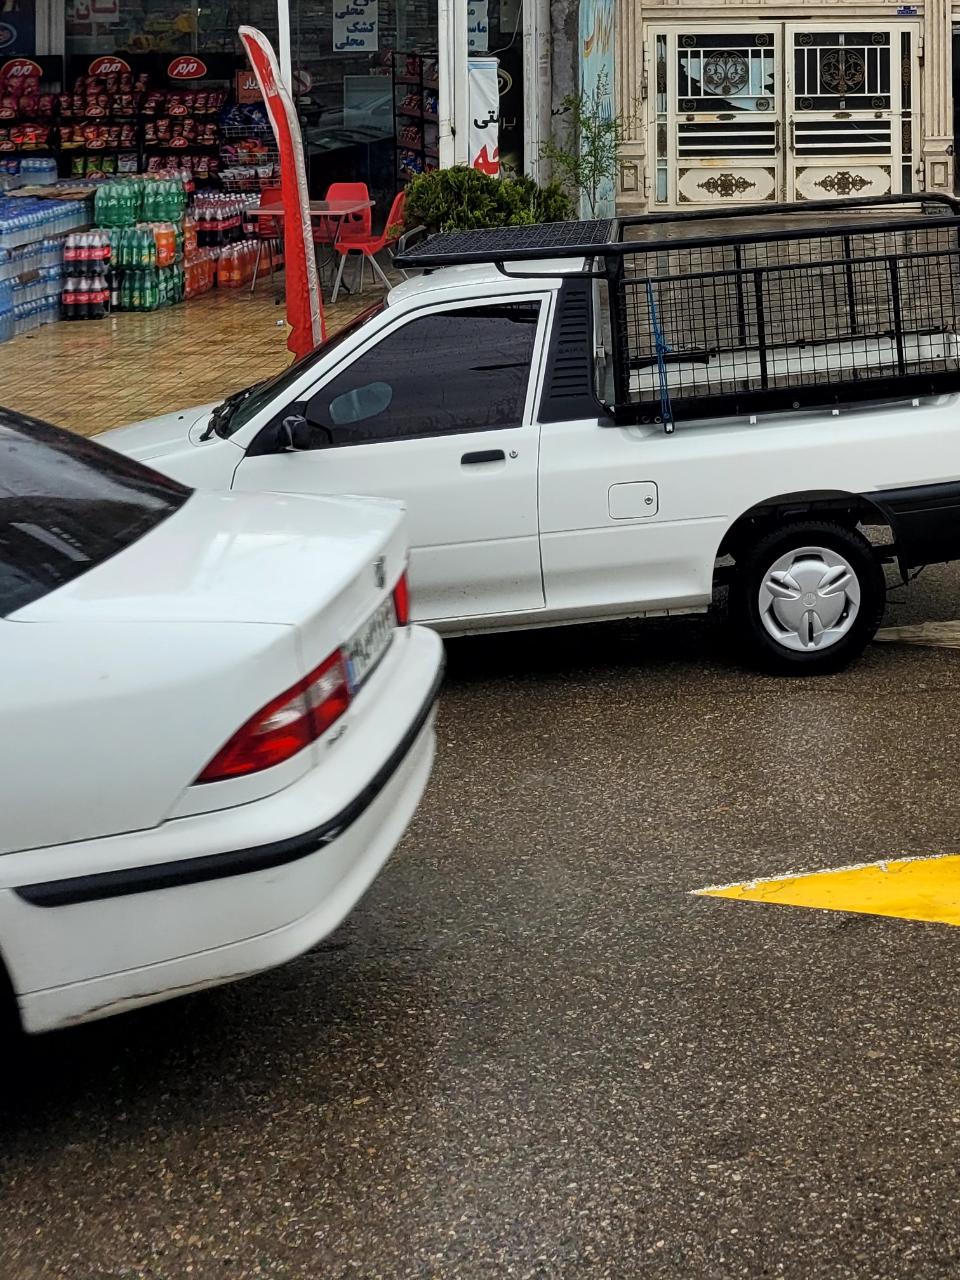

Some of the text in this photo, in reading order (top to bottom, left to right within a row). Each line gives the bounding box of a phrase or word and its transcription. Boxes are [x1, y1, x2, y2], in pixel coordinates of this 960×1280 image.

[335, 5, 365, 19] محلی
[346, 21, 375, 33] کشک
[335, 36, 365, 50] محلی
